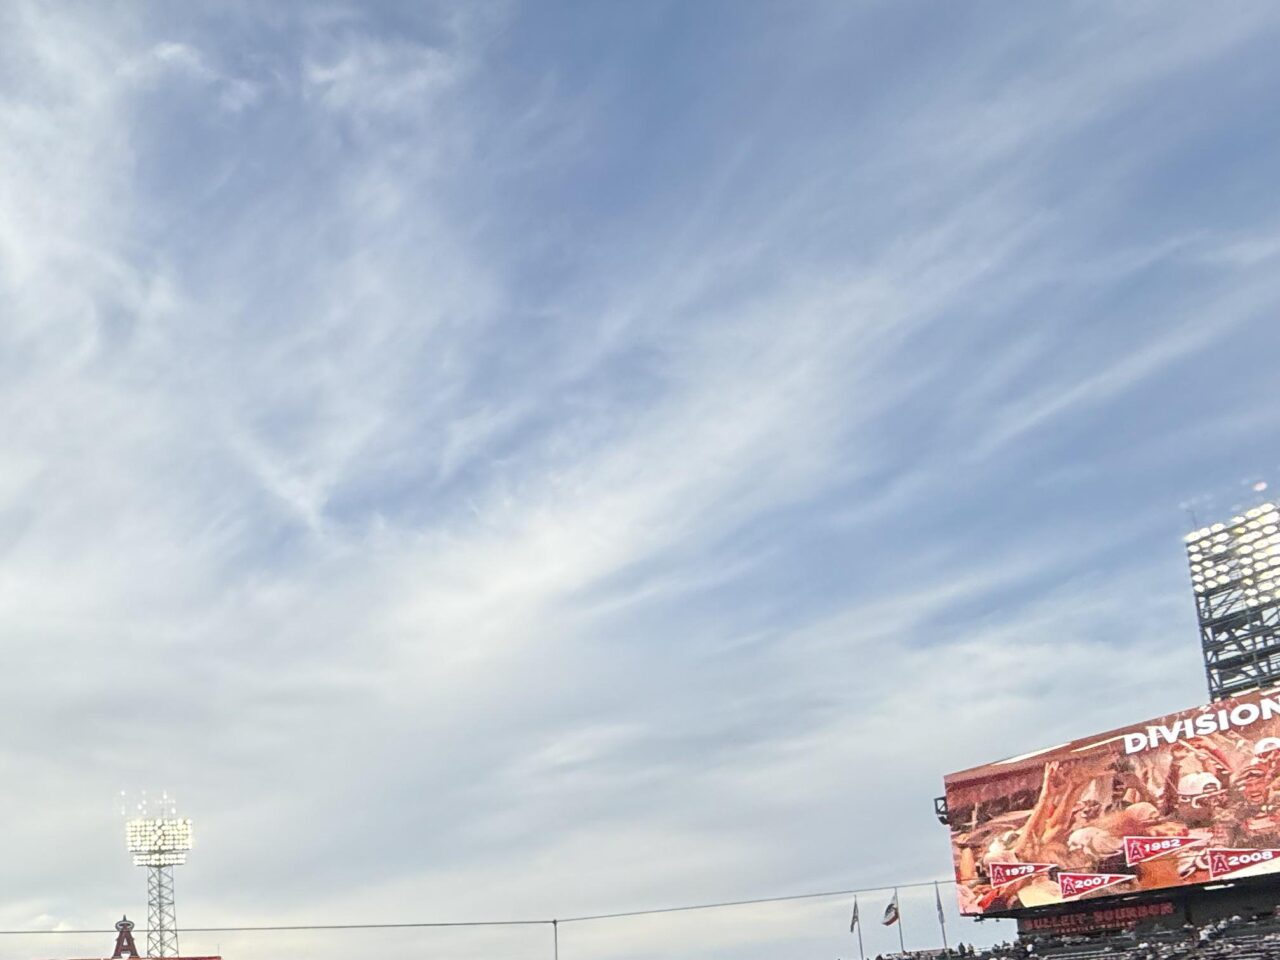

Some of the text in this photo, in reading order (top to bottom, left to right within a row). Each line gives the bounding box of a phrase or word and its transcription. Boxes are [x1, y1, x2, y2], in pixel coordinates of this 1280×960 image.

[1124, 696, 1280, 754] DIVISION
[1144, 839, 1181, 852] 1982
[1228, 851, 1273, 866] 2008
[1005, 865, 1034, 876] 1979
[1075, 876, 1110, 888] 2007
